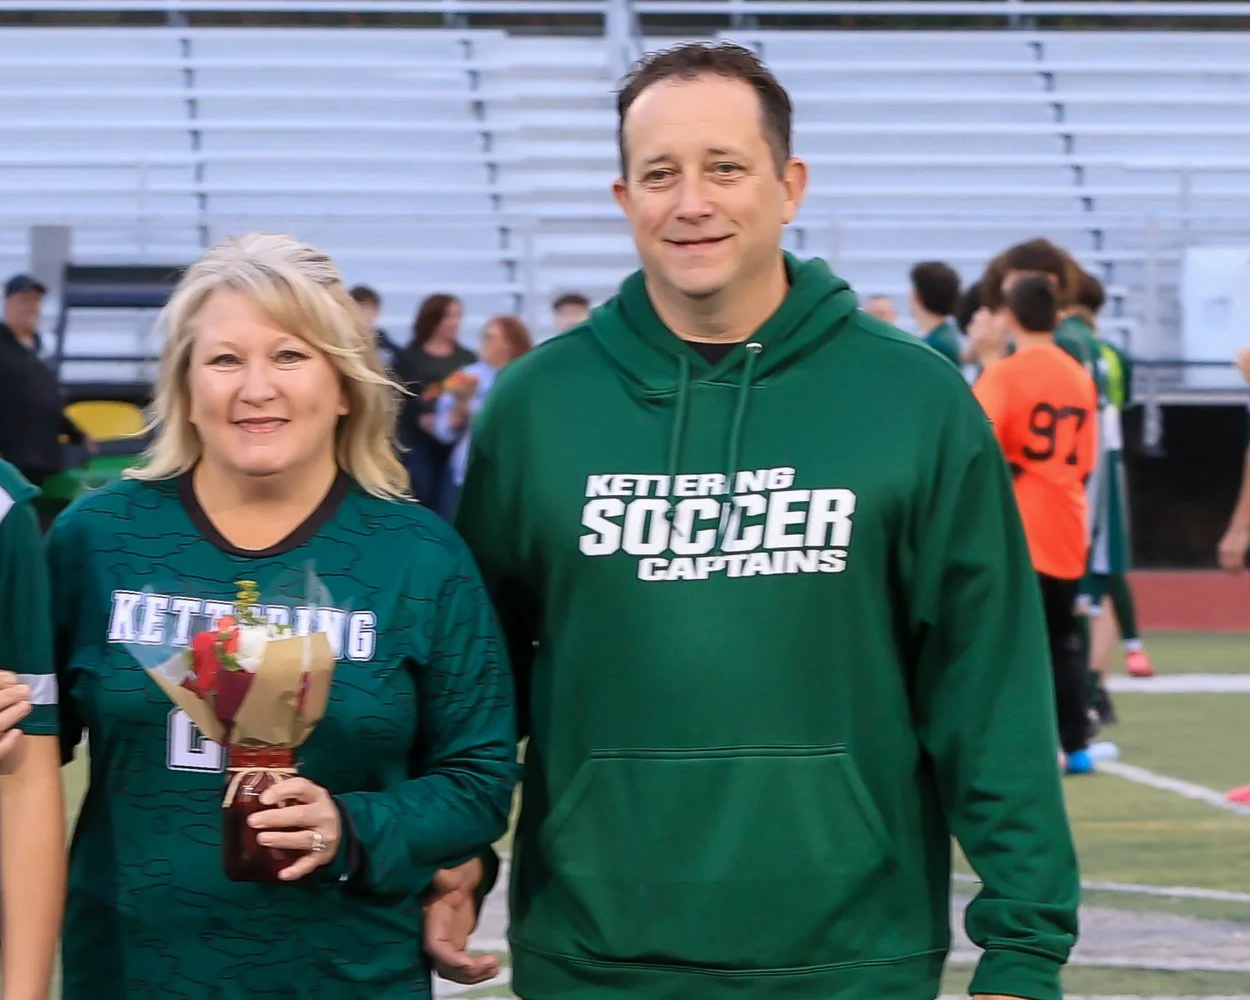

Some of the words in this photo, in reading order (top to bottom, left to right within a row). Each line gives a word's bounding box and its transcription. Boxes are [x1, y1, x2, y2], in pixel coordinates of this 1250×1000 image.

[1022, 402, 1088, 465] 97
[585, 467, 796, 498] KETTERNG
[578, 488, 857, 556] SOCCER
[637, 549, 848, 581] CAPTAINS
[107, 589, 378, 661] KETTING
